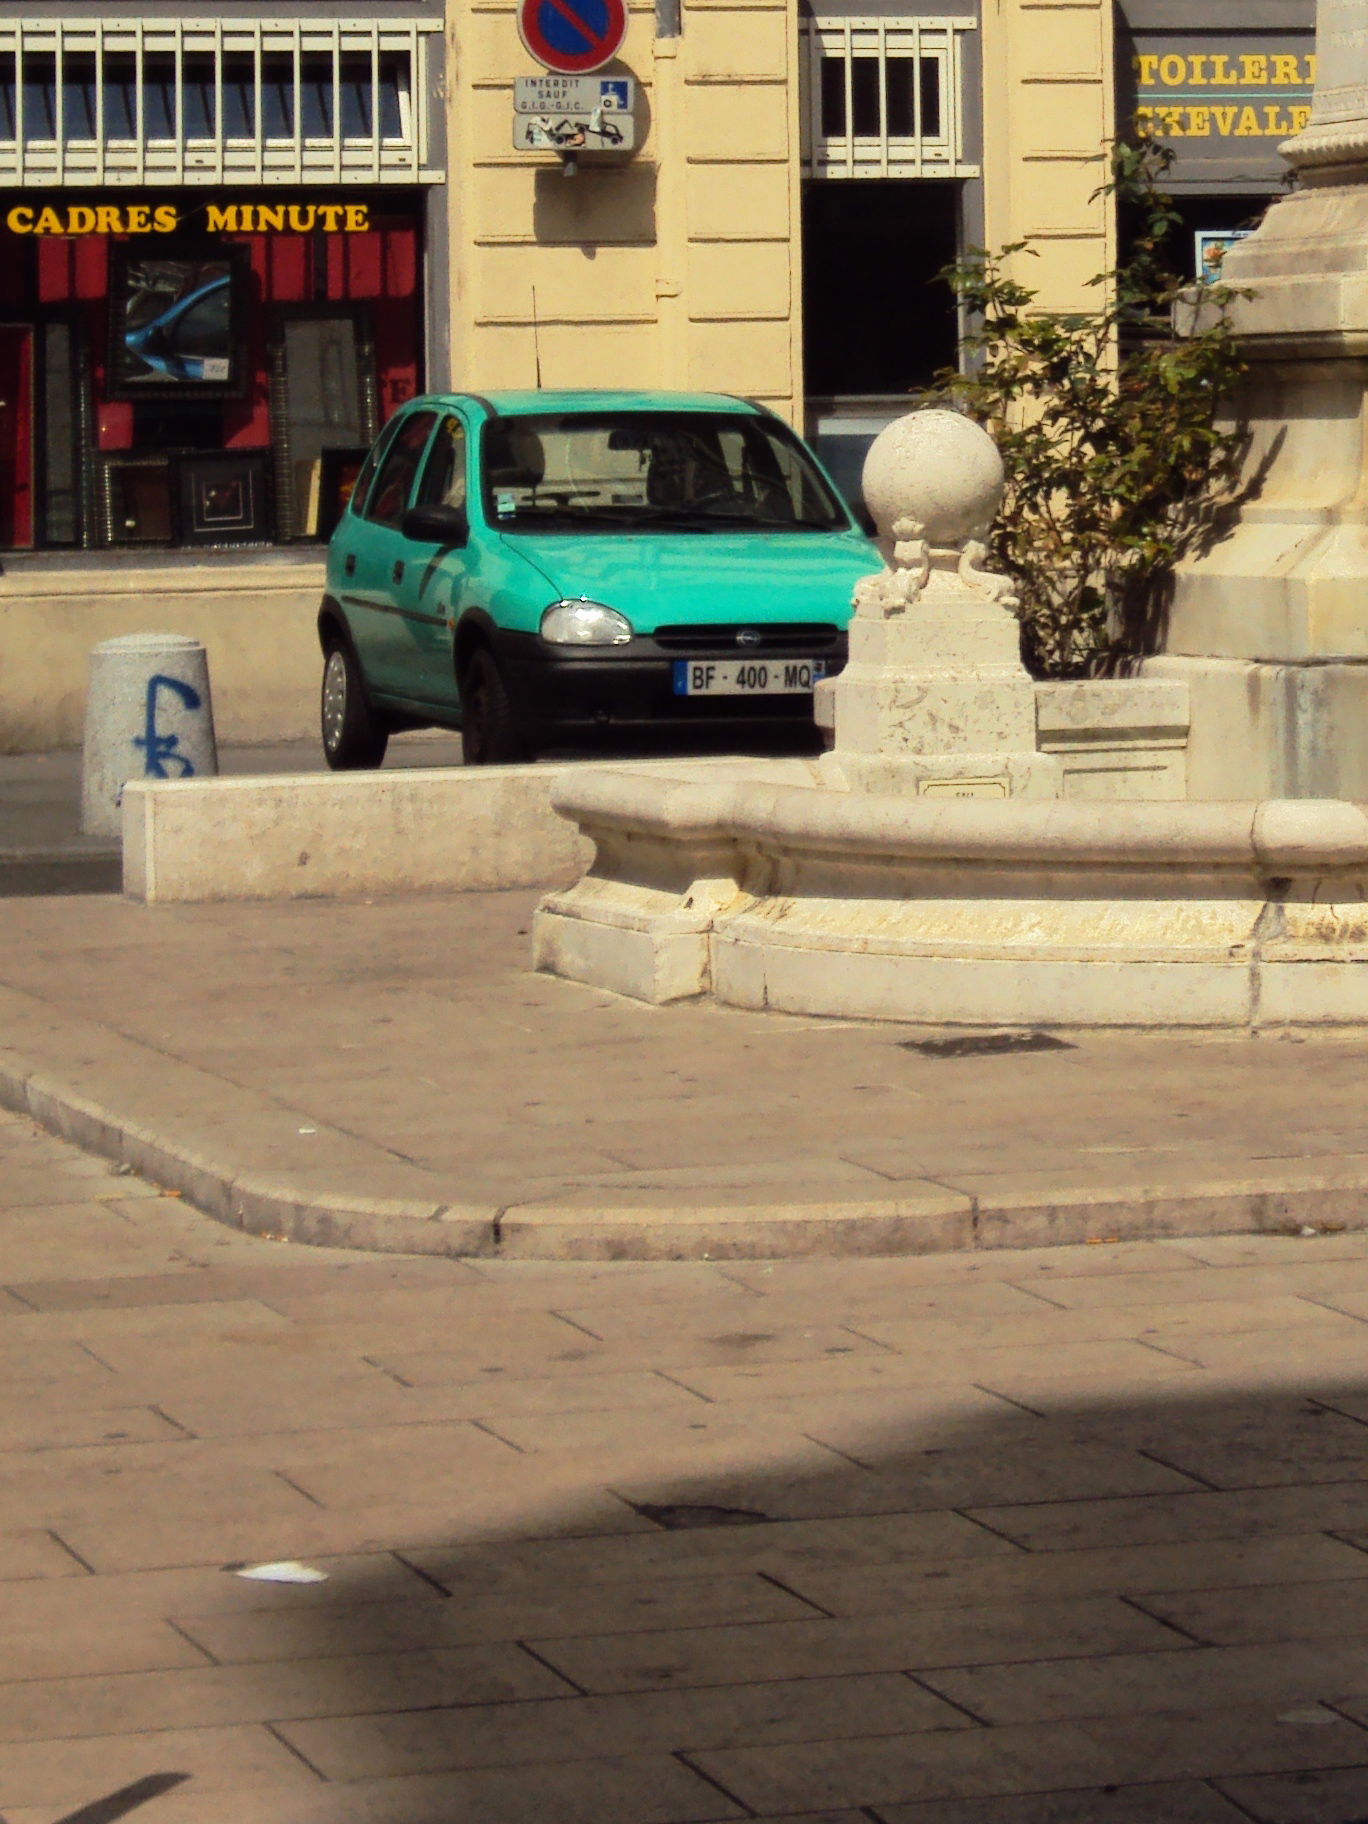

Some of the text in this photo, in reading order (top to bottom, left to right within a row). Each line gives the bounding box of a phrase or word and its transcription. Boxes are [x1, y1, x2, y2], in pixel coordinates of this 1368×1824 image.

[525, 79, 580, 88] INTERDIT
[537, 90, 568, 99] SAUF
[6, 204, 370, 234] CADRES MINUTE
